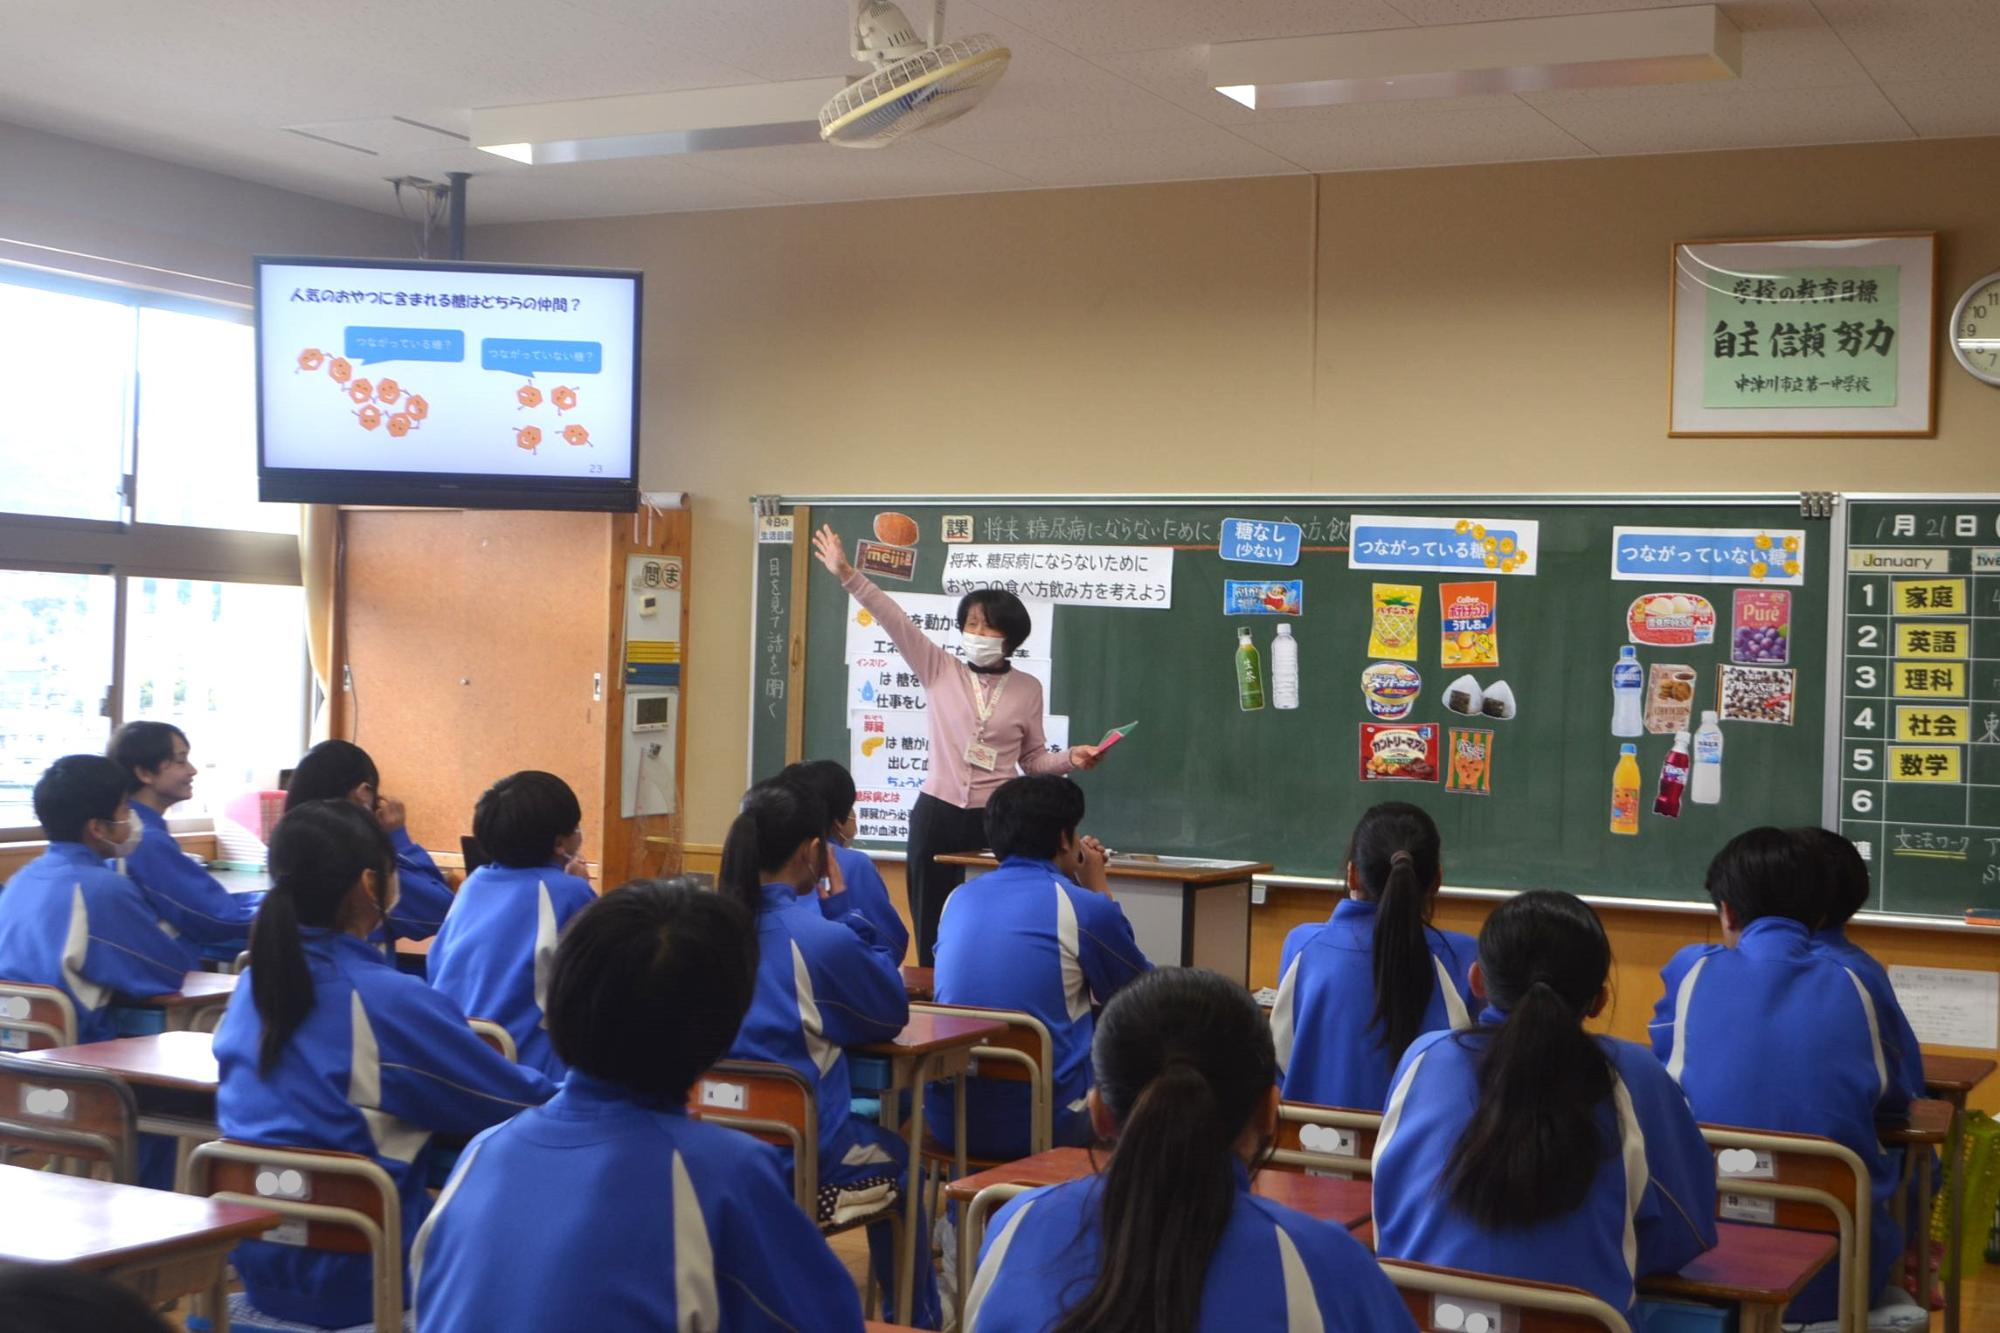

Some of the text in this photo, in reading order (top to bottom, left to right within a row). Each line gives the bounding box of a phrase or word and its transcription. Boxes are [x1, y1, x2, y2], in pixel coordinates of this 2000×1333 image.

[290, 287, 581, 312] 人気のおやつに含まれる糖はどちらの仲間？
[1732, 278, 1880, 304] 学校の教育目標
[1988, 292, 1999, 306] 11
[1973, 305, 1987, 319] 10
[1713, 319, 1896, 359] 自主 信頼 努力
[1966, 323, 1977, 337] 9
[1989, 353, 1998, 367] 7
[1735, 374, 1872, 393] 中津川市立第一中学校
[589, 464, 603, 474] 23
[946, 519, 969, 537] 課
[982, 515, 1020, 541] 将来
[1235, 522, 1286, 543] 糖なし
[1892, 514, 1916, 537] 月
[1955, 514, 1977, 537] 日
[867, 548, 905, 568] meiji
[1235, 543, 1283, 561] (少ない)
[1357, 539, 1487, 560] つながっている糖
[1621, 545, 1787, 567] つながっていない糖
[949, 552, 1149, 572] 将来、糖尿病にならないために
[1862, 553, 1933, 569] January
[946, 579, 1166, 601] おやつの食べ方飲み方を考えよう
[1862, 584, 1873, 606] 1
[1905, 585, 1953, 608] 家庭
[1857, 625, 1878, 648] 2
[1907, 630, 1957, 653] 英語
[880, 672, 892, 685] は
[1855, 666, 1876, 689] 3
[1905, 668, 1953, 691] 理科
[1853, 707, 1876, 730] 4
[1908, 714, 1957, 737] 社会
[1853, 748, 1874, 771] 5
[1900, 754, 1948, 777] 数学
[1852, 789, 1873, 812] 6
